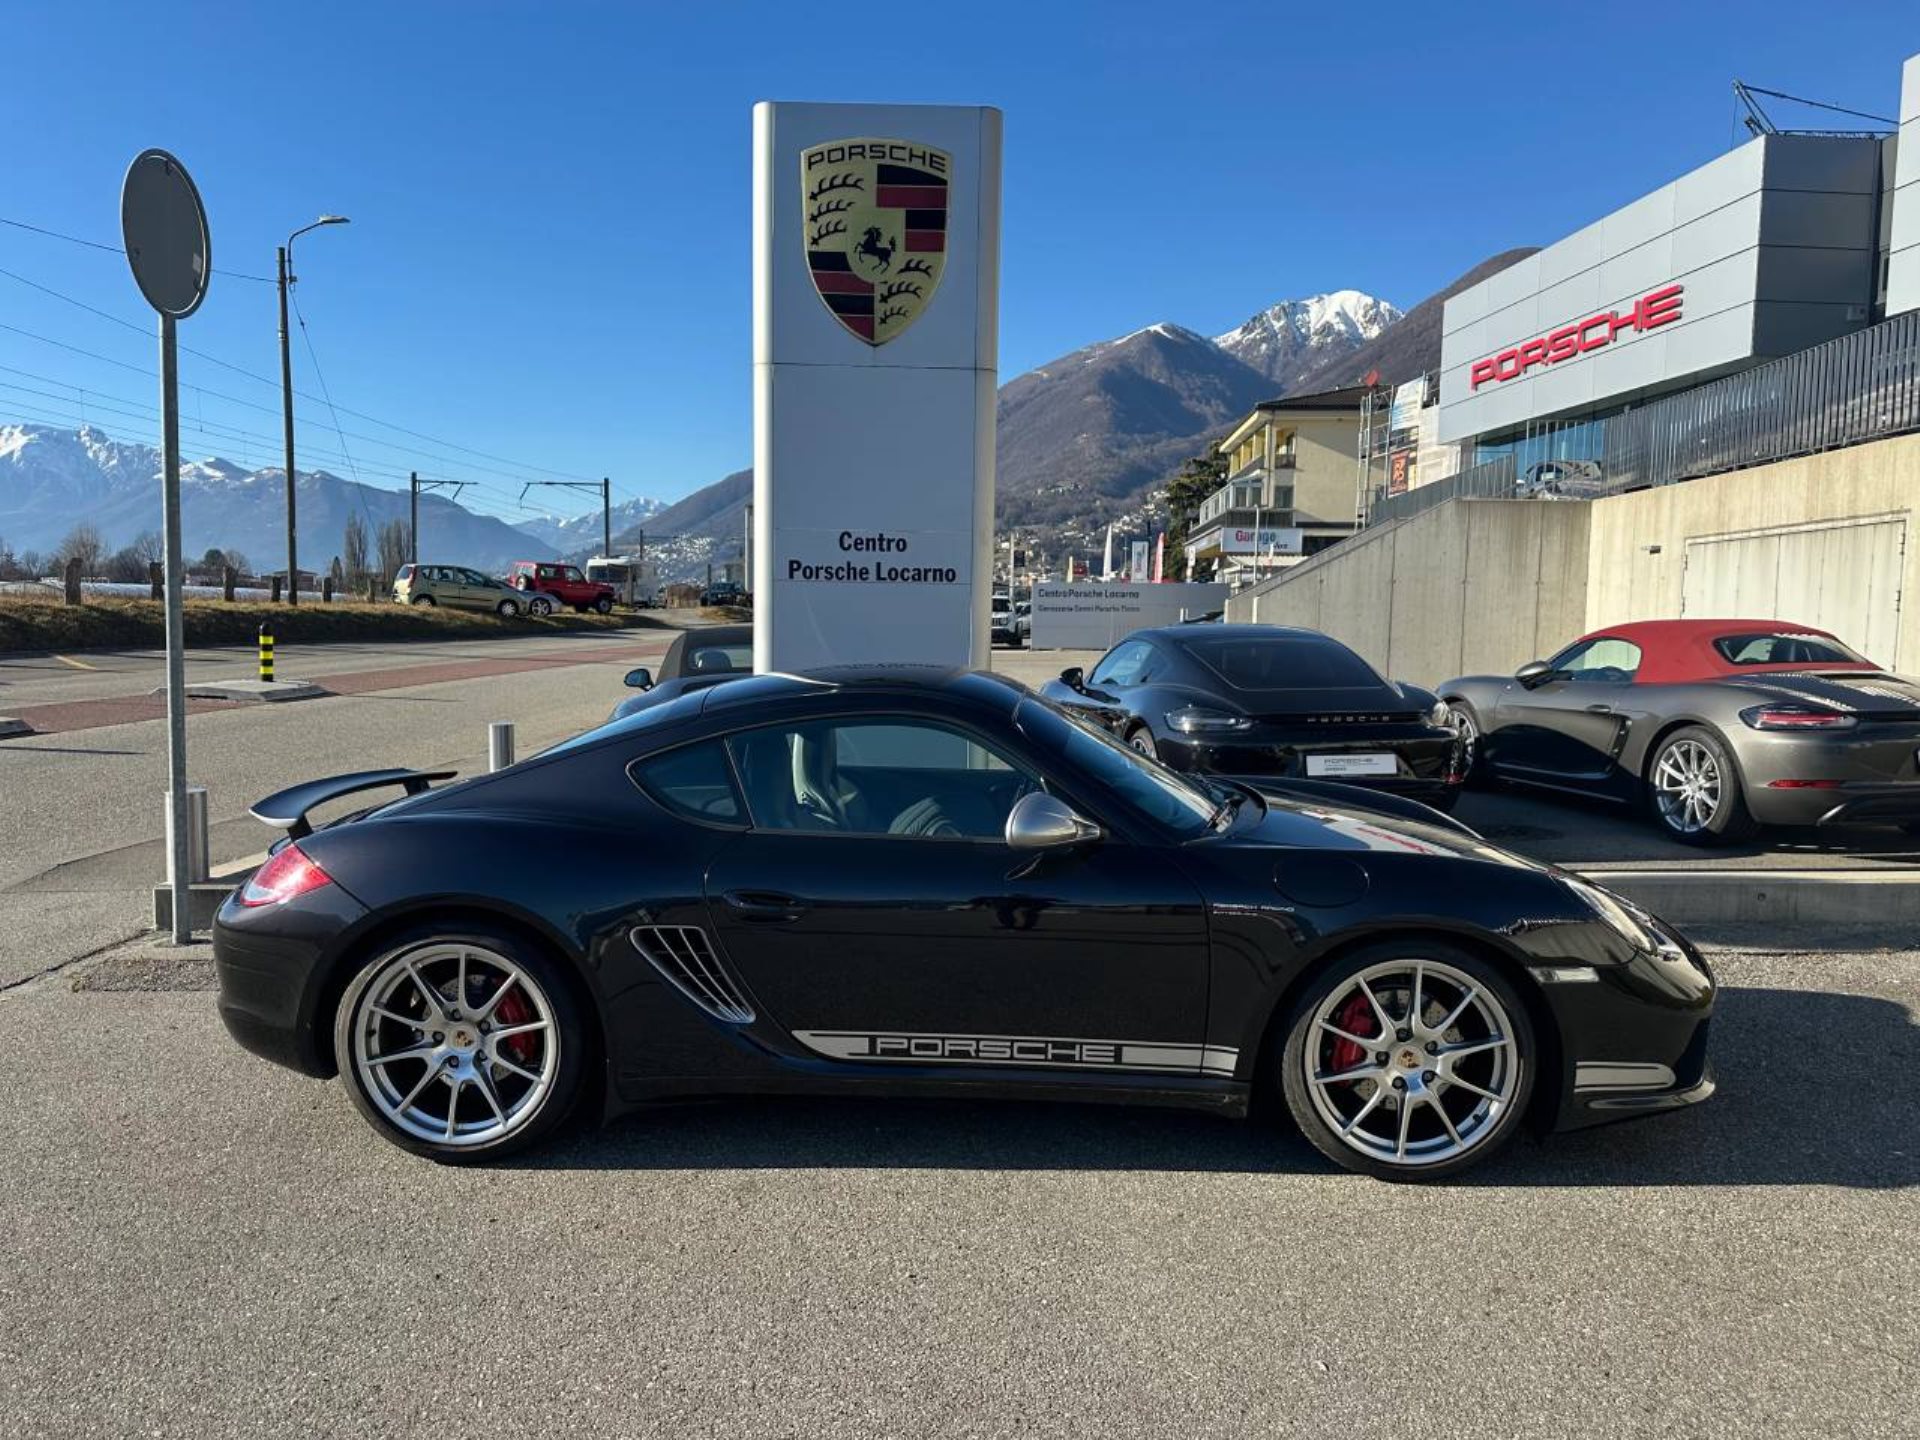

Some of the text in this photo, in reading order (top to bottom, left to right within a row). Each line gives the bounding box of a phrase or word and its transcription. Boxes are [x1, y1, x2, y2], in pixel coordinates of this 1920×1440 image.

[807, 144, 947, 173] PORSCHE
[1471, 284, 1685, 391] PORSCHE
[838, 530, 908, 552] Centro
[788, 559, 957, 583] Porsche Locarno
[1038, 588, 1140, 599] Centro Porsche Locarno
[876, 1038, 1115, 1063] PORSCHE
